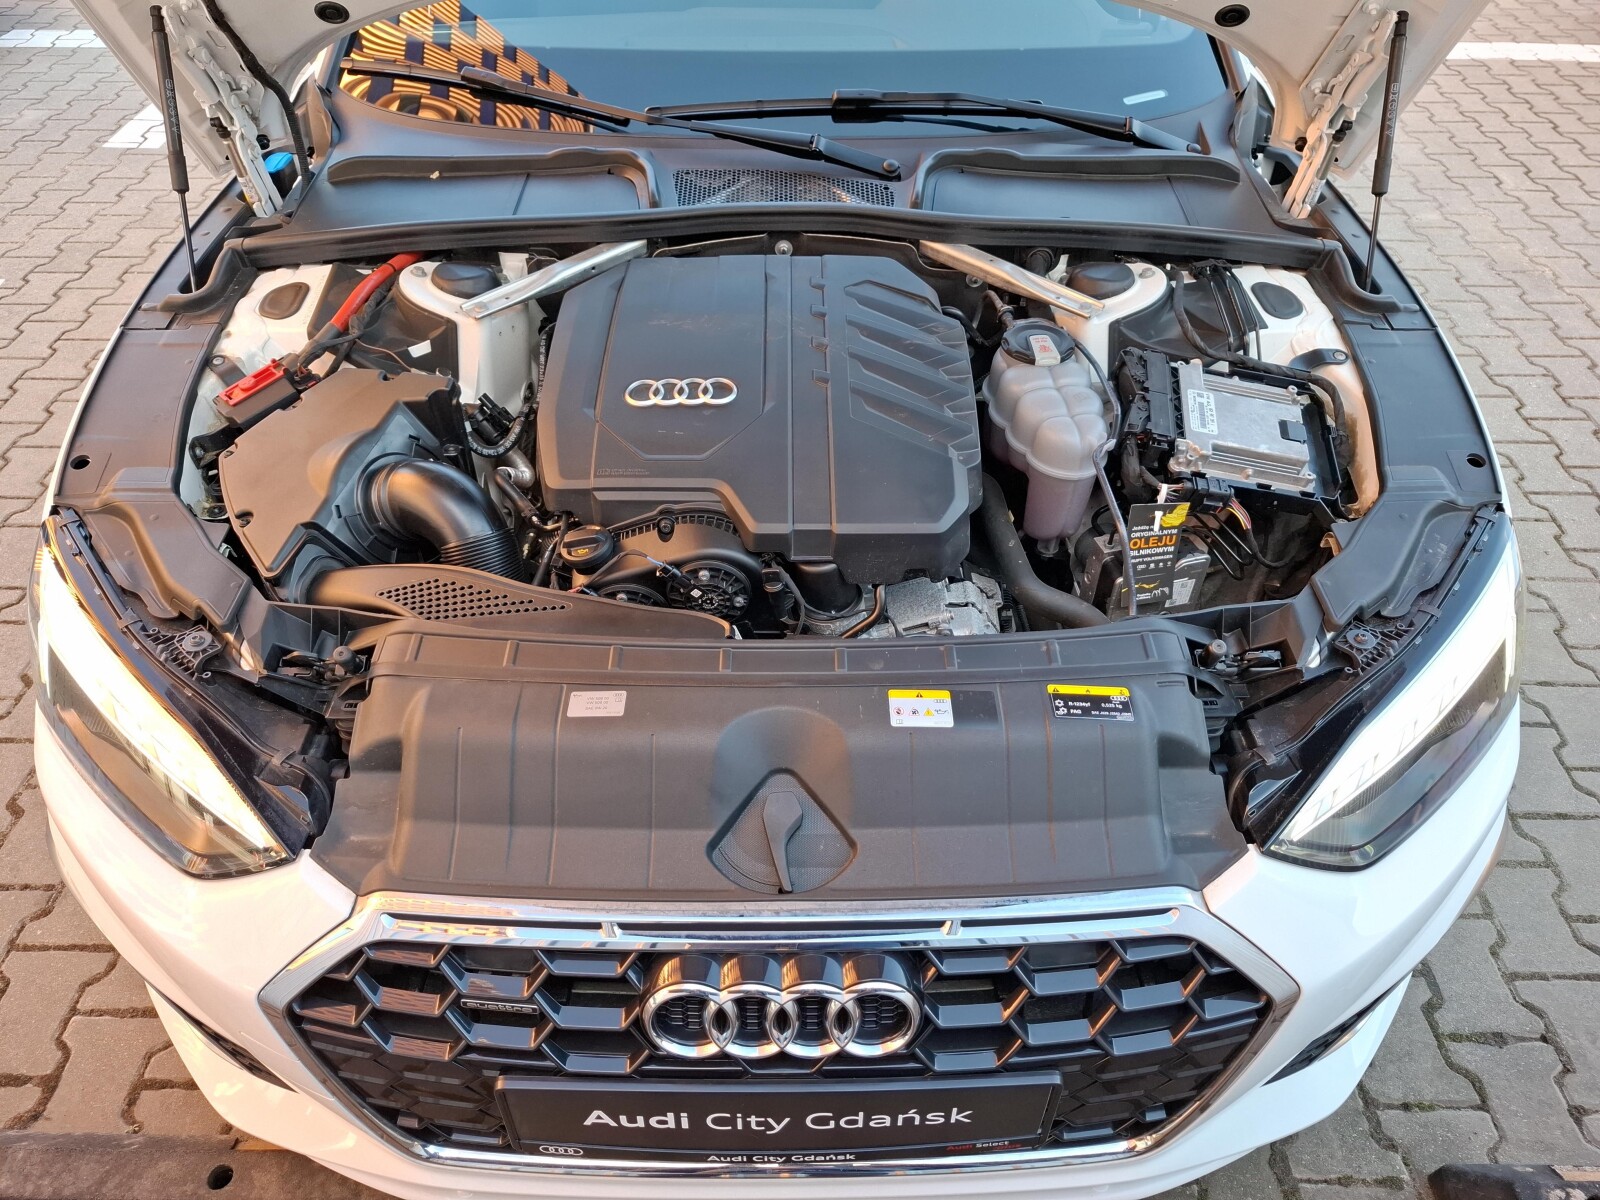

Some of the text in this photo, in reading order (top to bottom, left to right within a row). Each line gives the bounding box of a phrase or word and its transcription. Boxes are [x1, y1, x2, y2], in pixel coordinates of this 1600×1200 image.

[1129, 535, 1177, 550] OLEJU
[1130, 546, 1174, 556] SILNIKOWYM
[466, 1002, 533, 1013] quattro
[583, 1107, 974, 1135] Audi City Gdańsk
[975, 1140, 1010, 1148] Select
[752, 1155, 787, 1163] City
[791, 1153, 857, 1162] Gdańsk
